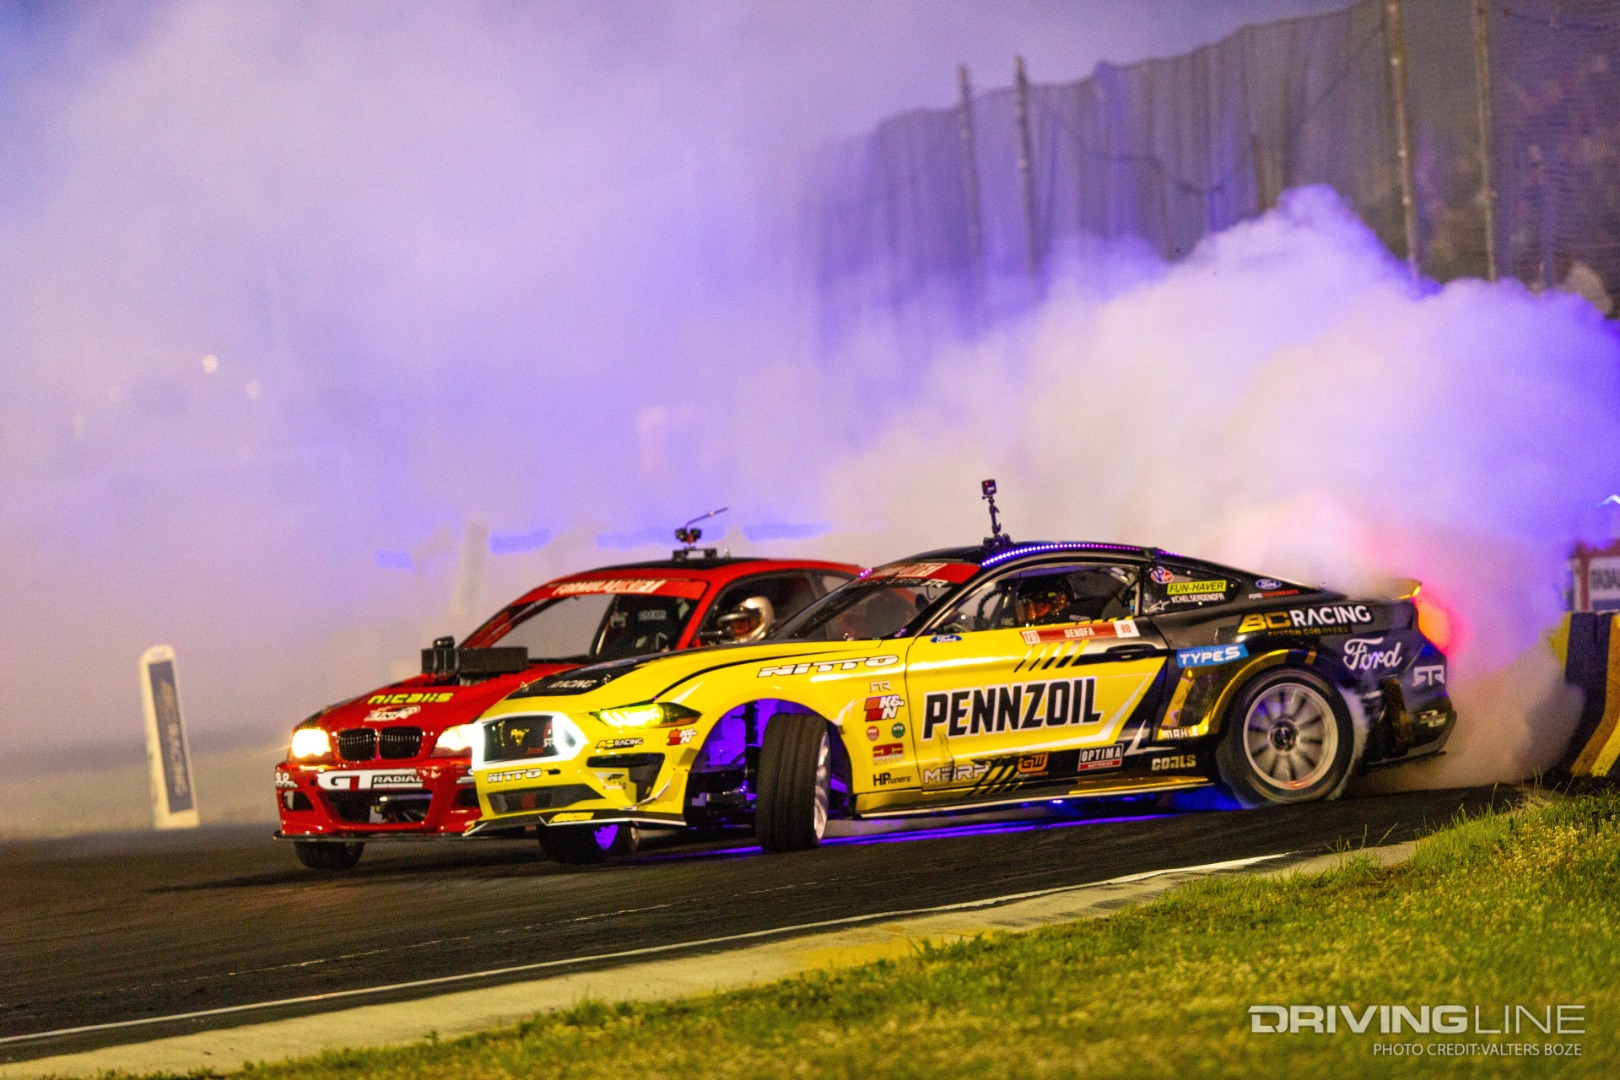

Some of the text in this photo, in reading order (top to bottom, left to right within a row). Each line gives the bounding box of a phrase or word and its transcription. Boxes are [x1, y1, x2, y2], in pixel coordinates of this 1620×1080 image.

[1168, 580, 1225, 594] FUN-HAVER
[1290, 605, 1372, 628] RACING
[1064, 627, 1095, 639] DENOFA
[1343, 636, 1403, 670] Ford
[756, 654, 899, 678] NITTO
[922, 676, 1104, 741] PENNZOIL
[1080, 746, 1122, 762] OPTIMA
[317, 768, 417, 791] GT
[373, 774, 424, 784] RADIAL
[486, 767, 543, 784] NITTO
